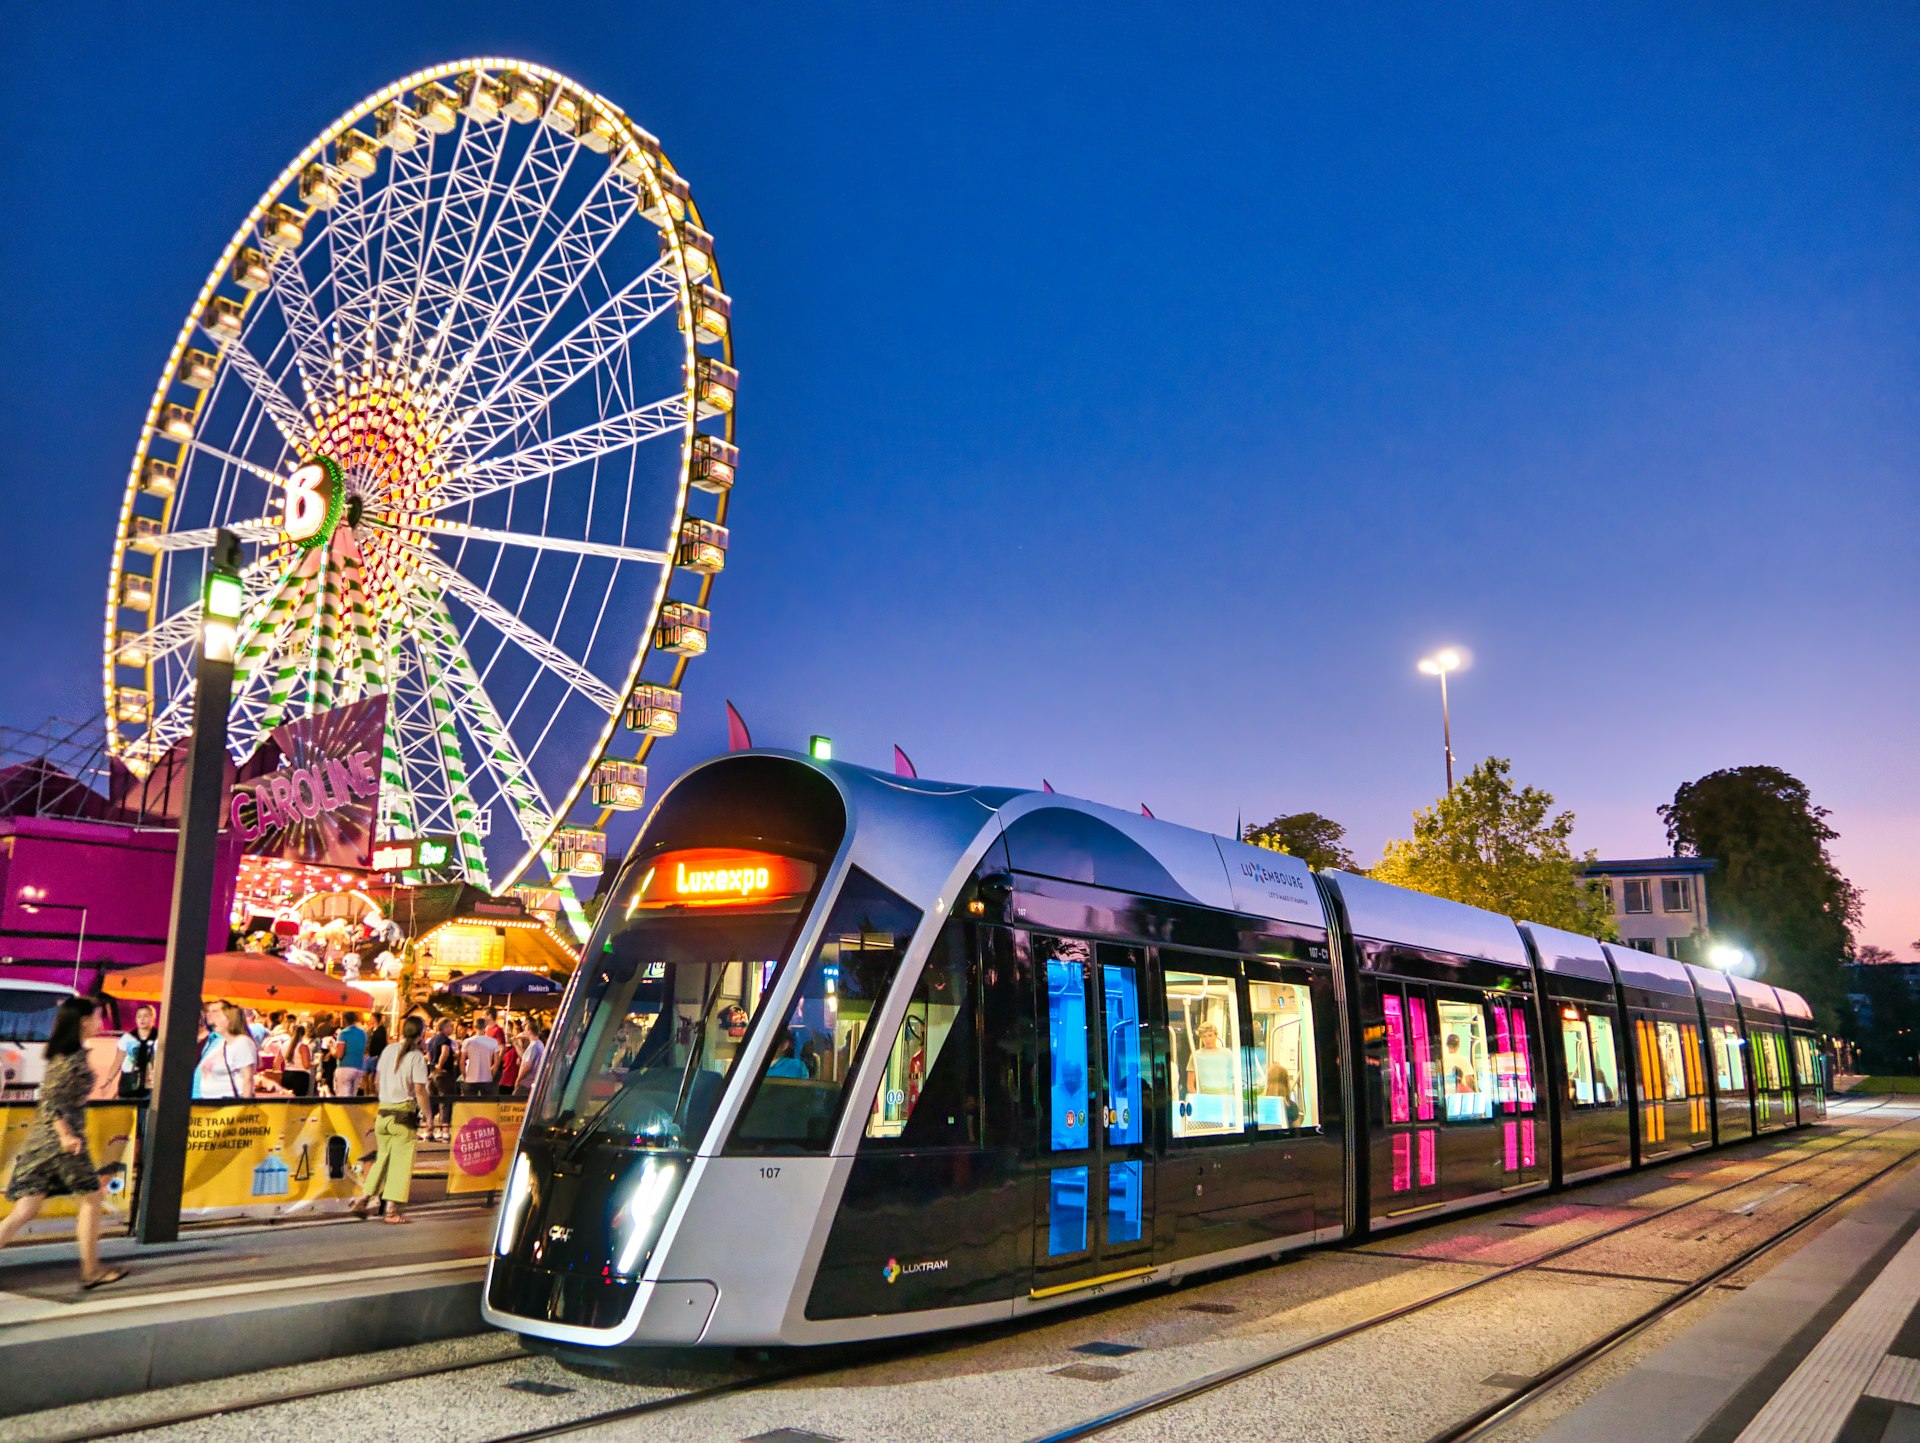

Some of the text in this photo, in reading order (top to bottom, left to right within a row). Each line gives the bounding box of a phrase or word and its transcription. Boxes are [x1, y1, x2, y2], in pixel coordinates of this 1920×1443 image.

[231, 750, 378, 842] CAROLINE
[677, 862, 769, 896] Luxexpo
[1241, 862, 1304, 889] LUXEMBOURG
[528, 984, 550, 993] Diekirch
[206, 1117, 234, 1126] TRAM
[460, 1127, 495, 1143] LE TRAM
[460, 1137, 496, 1153] GRATUIT
[759, 1167, 781, 1179] 107
[902, 1259, 949, 1274] LUXTRAM
